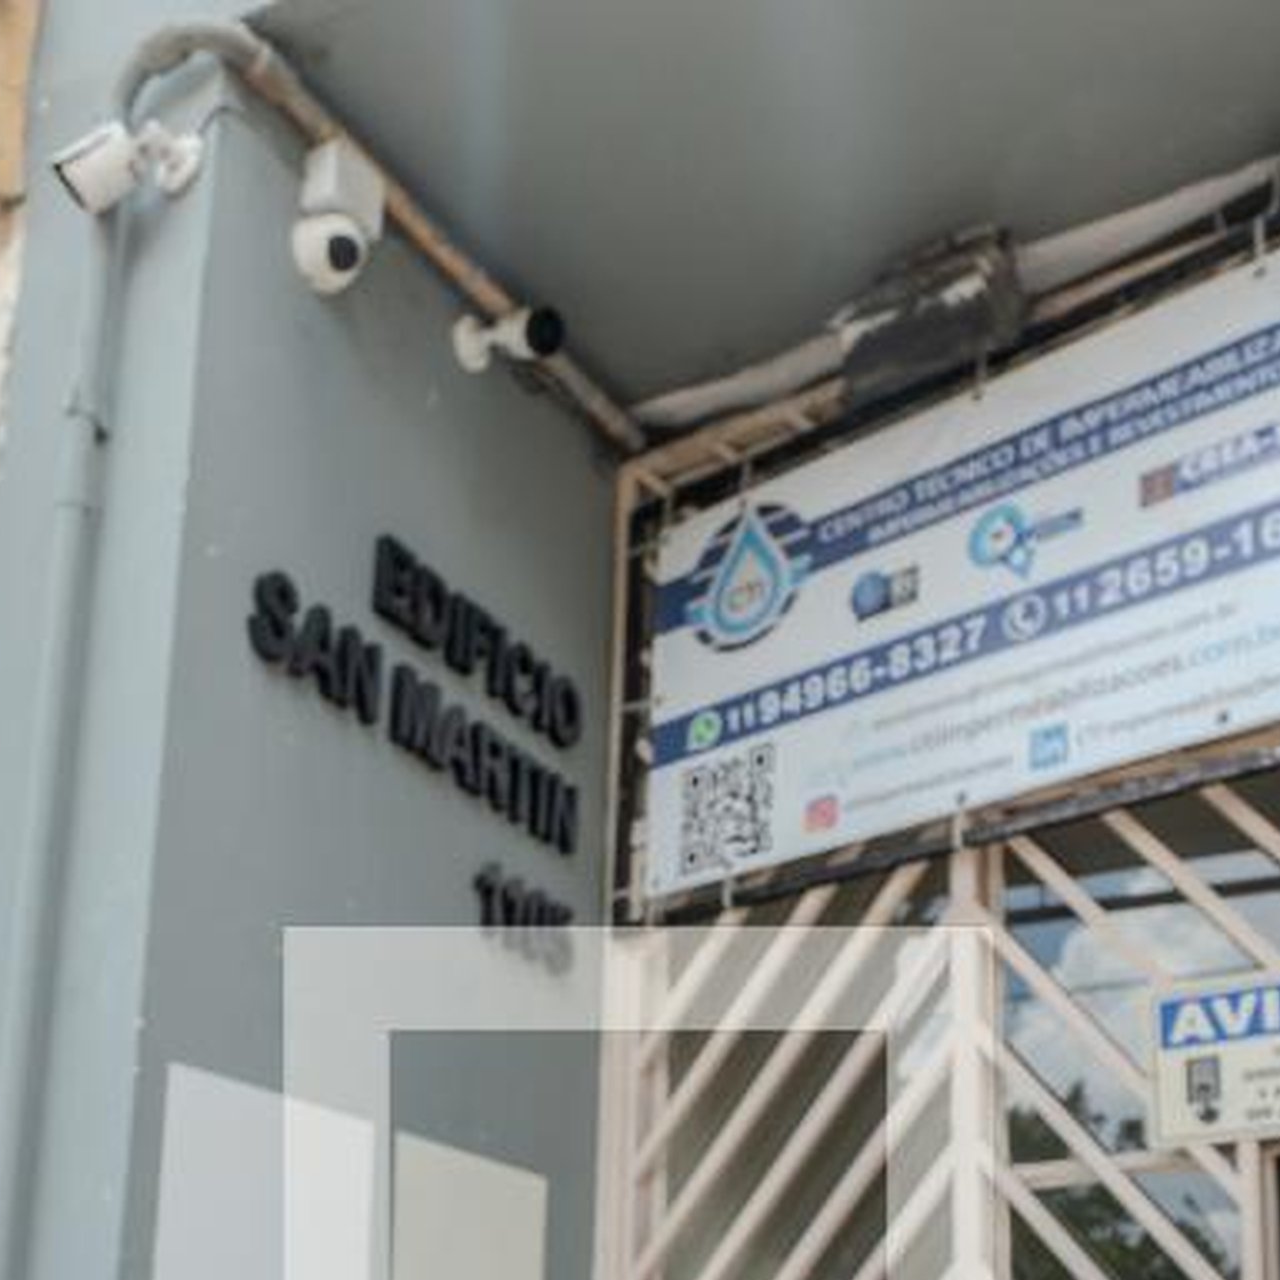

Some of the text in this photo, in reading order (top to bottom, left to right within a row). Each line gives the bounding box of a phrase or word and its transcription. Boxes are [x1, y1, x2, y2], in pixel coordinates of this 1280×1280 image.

[1020, 427, 1053, 458] DE
[247, 569, 580, 856] SAN MARTIN
[372, 533, 582, 748] EDIFICIO
